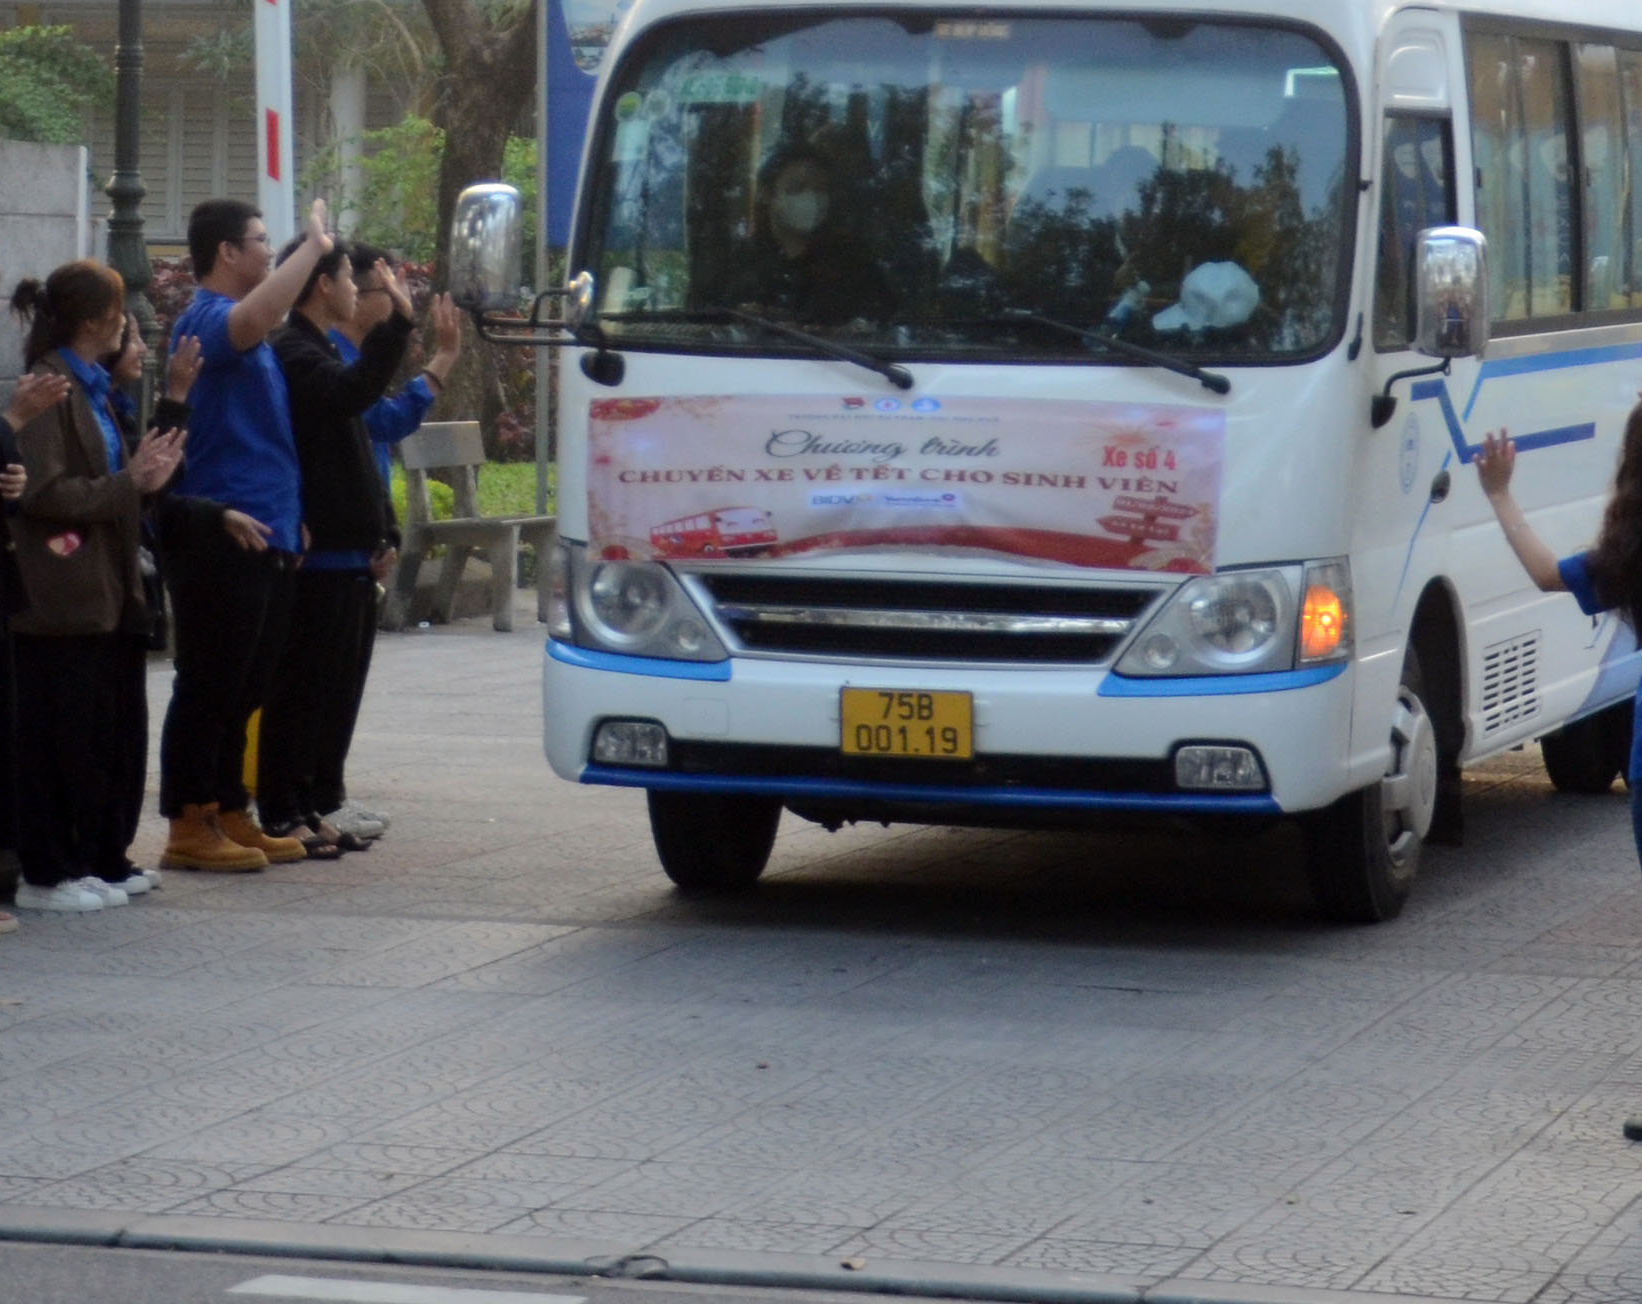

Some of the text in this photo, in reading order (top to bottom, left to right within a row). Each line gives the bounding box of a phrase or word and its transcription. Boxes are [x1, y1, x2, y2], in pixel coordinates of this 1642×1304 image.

[919, 435, 1000, 457] trình
[1102, 445, 1127, 467] Xe
[1164, 449, 1176, 470] 4
[754, 468, 794, 482] XE
[920, 468, 994, 484] CHO
[1002, 471, 1086, 489] SINH
[1097, 475, 1179, 494] VIÊN
[878, 692, 934, 721] 75B
[855, 724, 959, 754] 001.19
